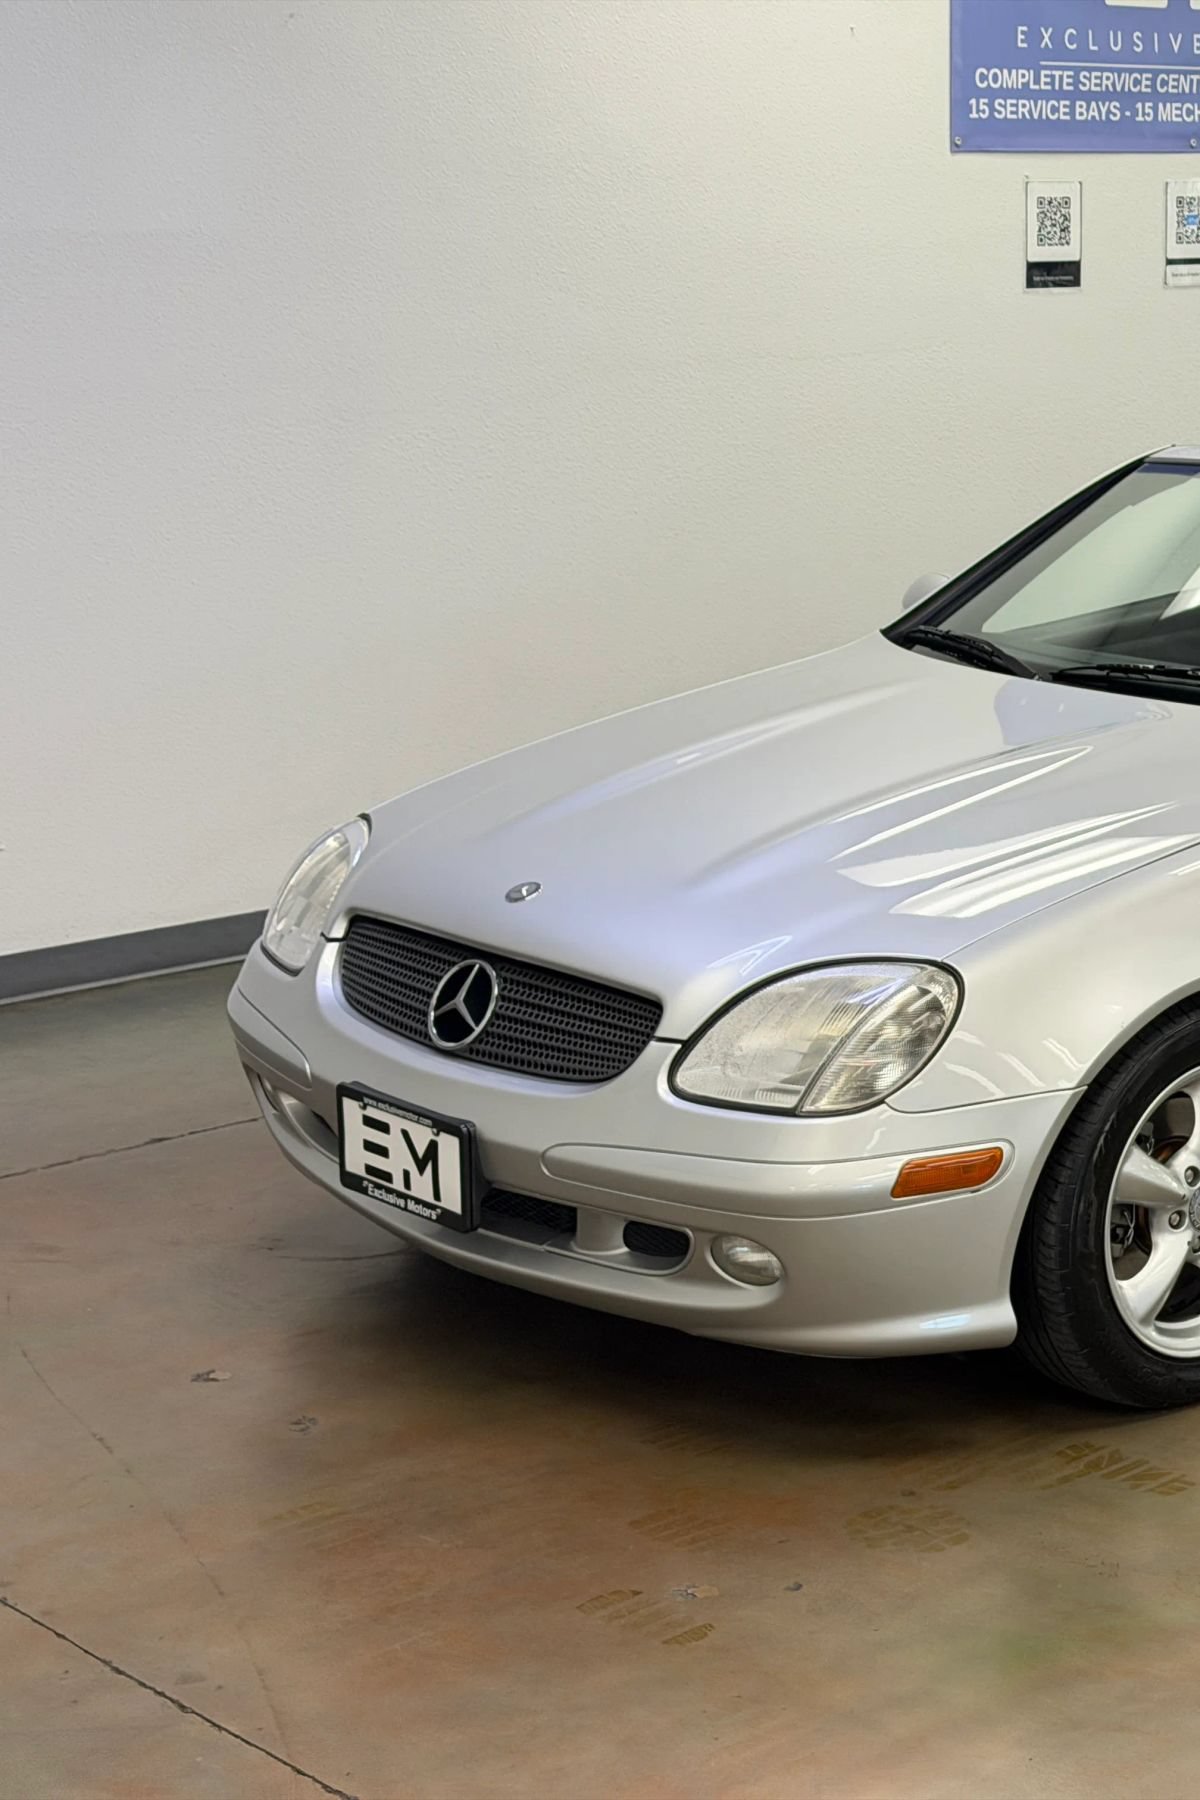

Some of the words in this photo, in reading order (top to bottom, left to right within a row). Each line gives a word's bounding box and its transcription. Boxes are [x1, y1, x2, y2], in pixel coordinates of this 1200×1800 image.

[975, 67, 1074, 91] COMPLETE
[1079, 70, 1152, 93] SERVICE
[968, 97, 989, 119] 15
[994, 99, 1070, 120] SERVICE
[1075, 100, 1121, 121] BAYS
[1135, 102, 1153, 122] 15
[361, 1113, 442, 1203] EM
